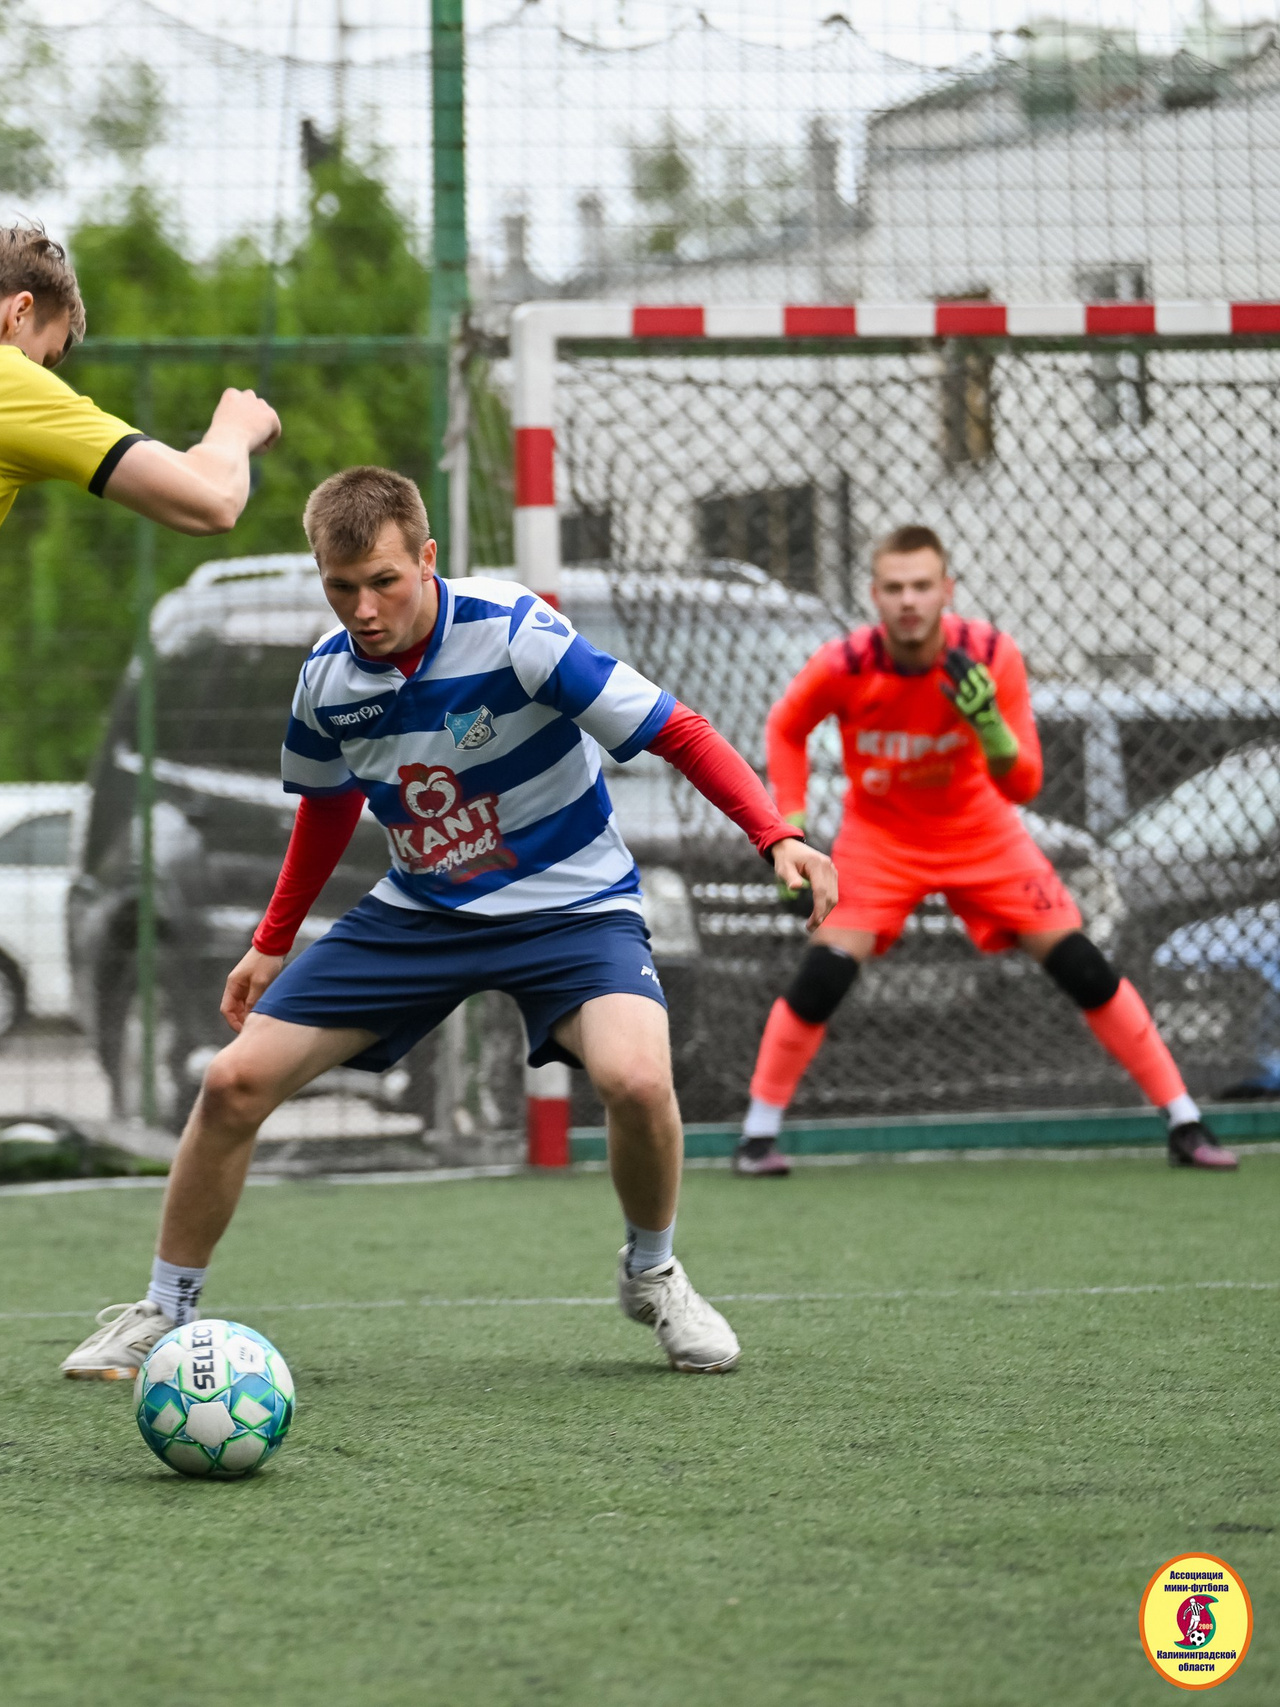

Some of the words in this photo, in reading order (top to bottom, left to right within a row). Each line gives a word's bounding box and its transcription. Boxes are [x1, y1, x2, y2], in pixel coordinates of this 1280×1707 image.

[328, 704, 384, 726] macron
[392, 796, 493, 859] KANT
[410, 828, 498, 876] arket
